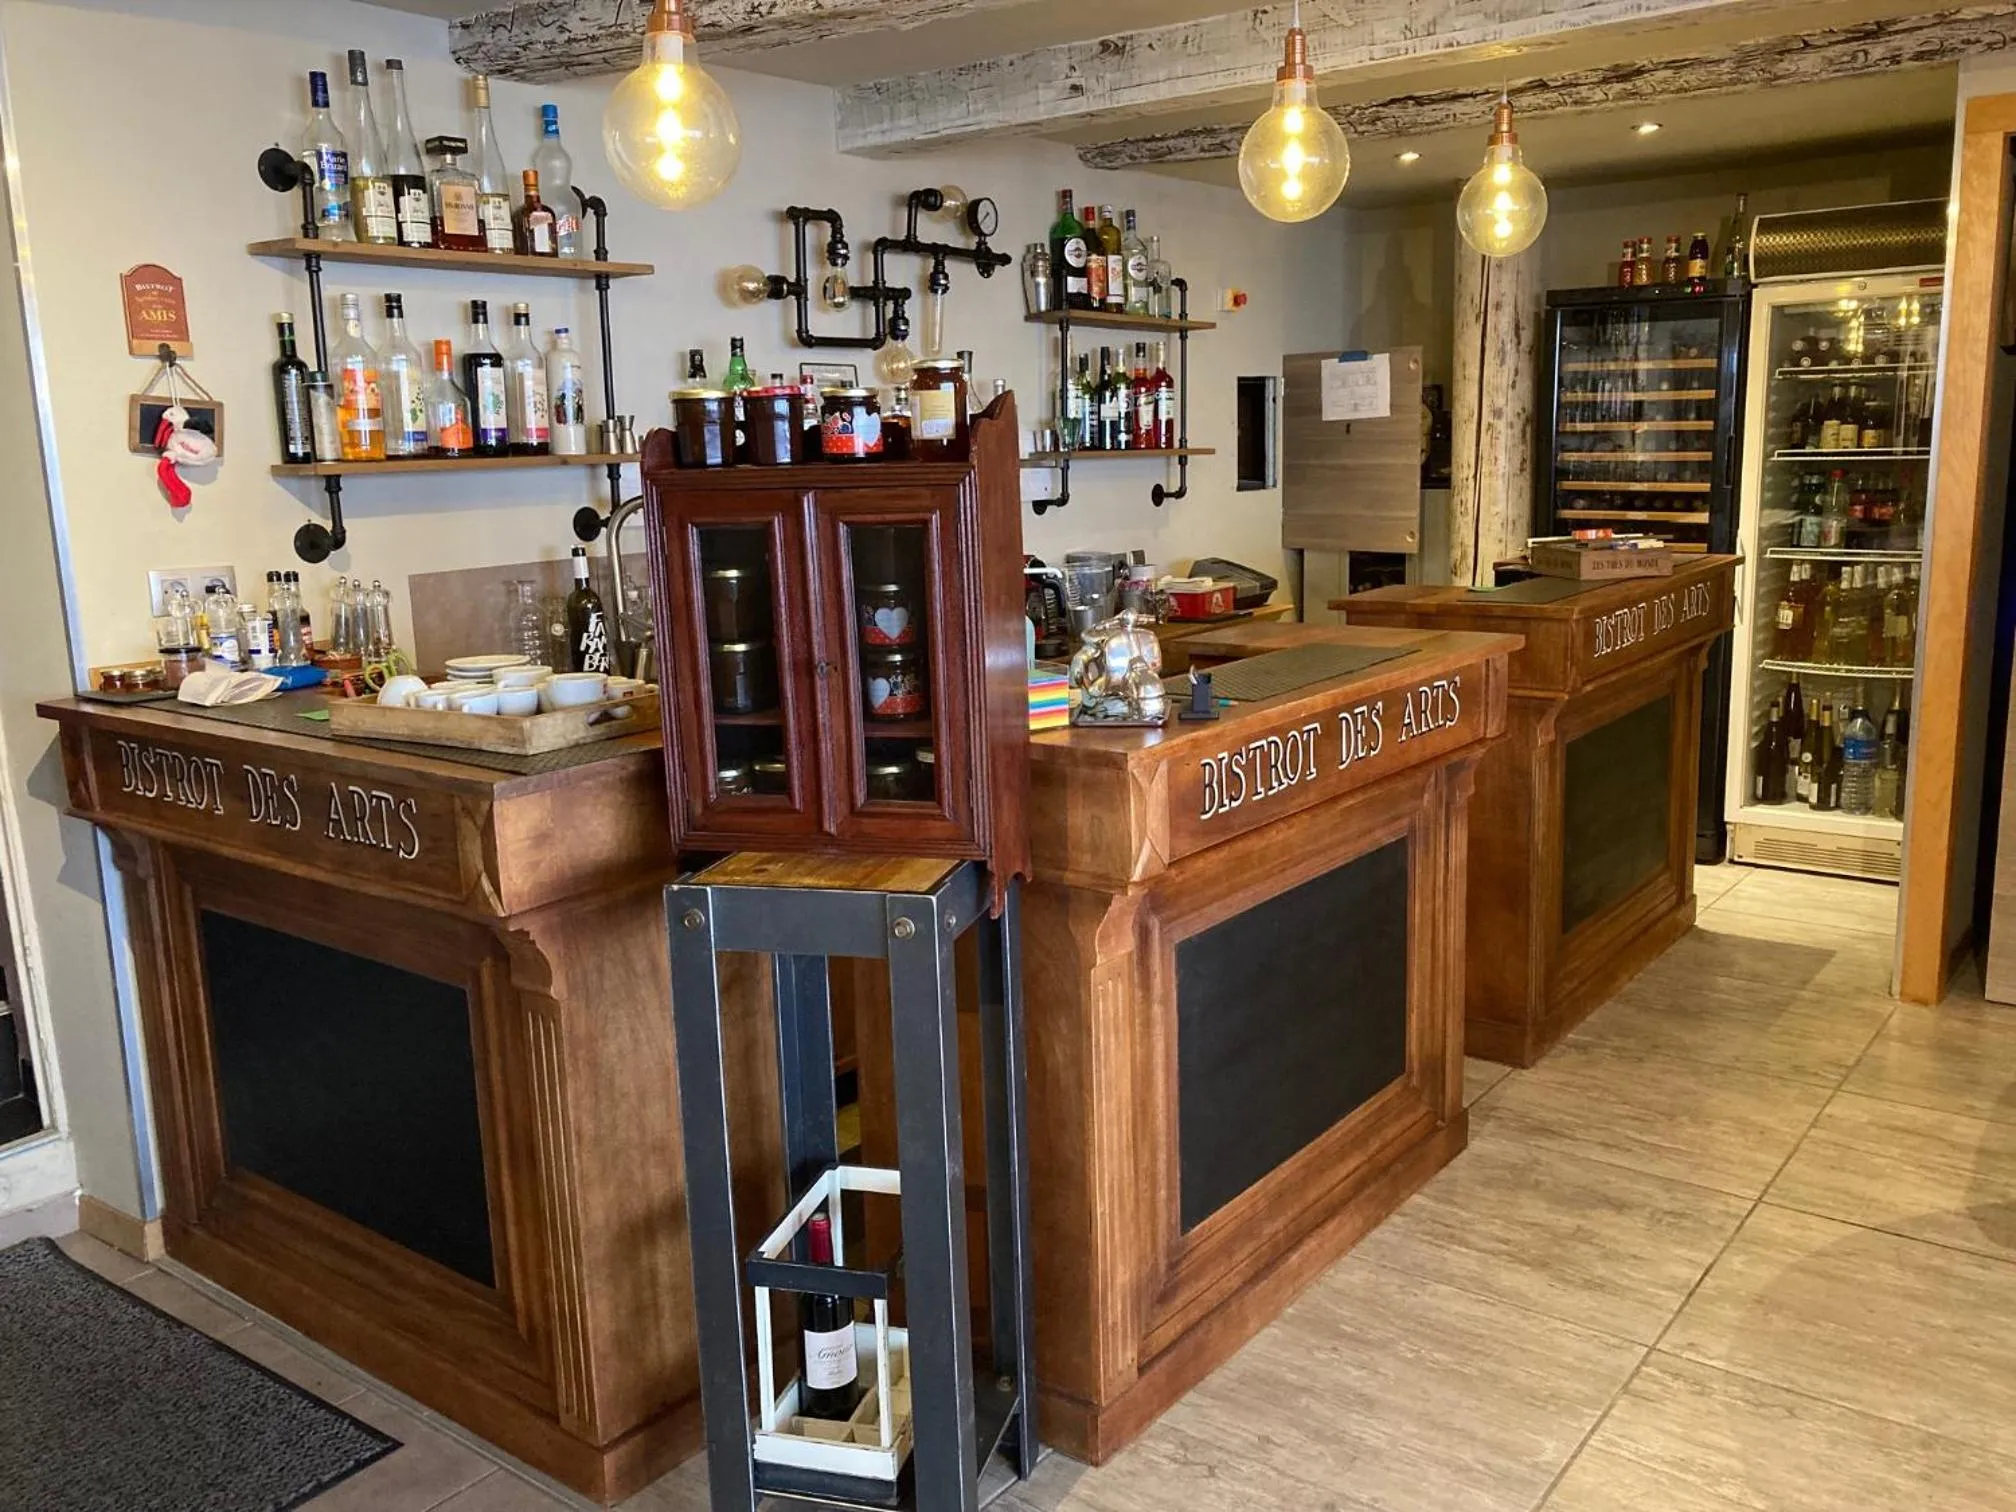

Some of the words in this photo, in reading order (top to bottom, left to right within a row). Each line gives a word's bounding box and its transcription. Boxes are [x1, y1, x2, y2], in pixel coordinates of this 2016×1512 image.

[140, 309, 177, 322] AMIS
[1593, 602, 1647, 658] BISTROT
[1652, 592, 1675, 635] DES
[1680, 581, 1710, 623] ARTS
[1199, 722, 1322, 821] BISTROT
[1338, 701, 1383, 770] DES
[1397, 675, 1461, 743] ARTS
[116, 740, 224, 815] BISTROT
[242, 764, 301, 831] DES
[323, 781, 419, 860] ARTS
